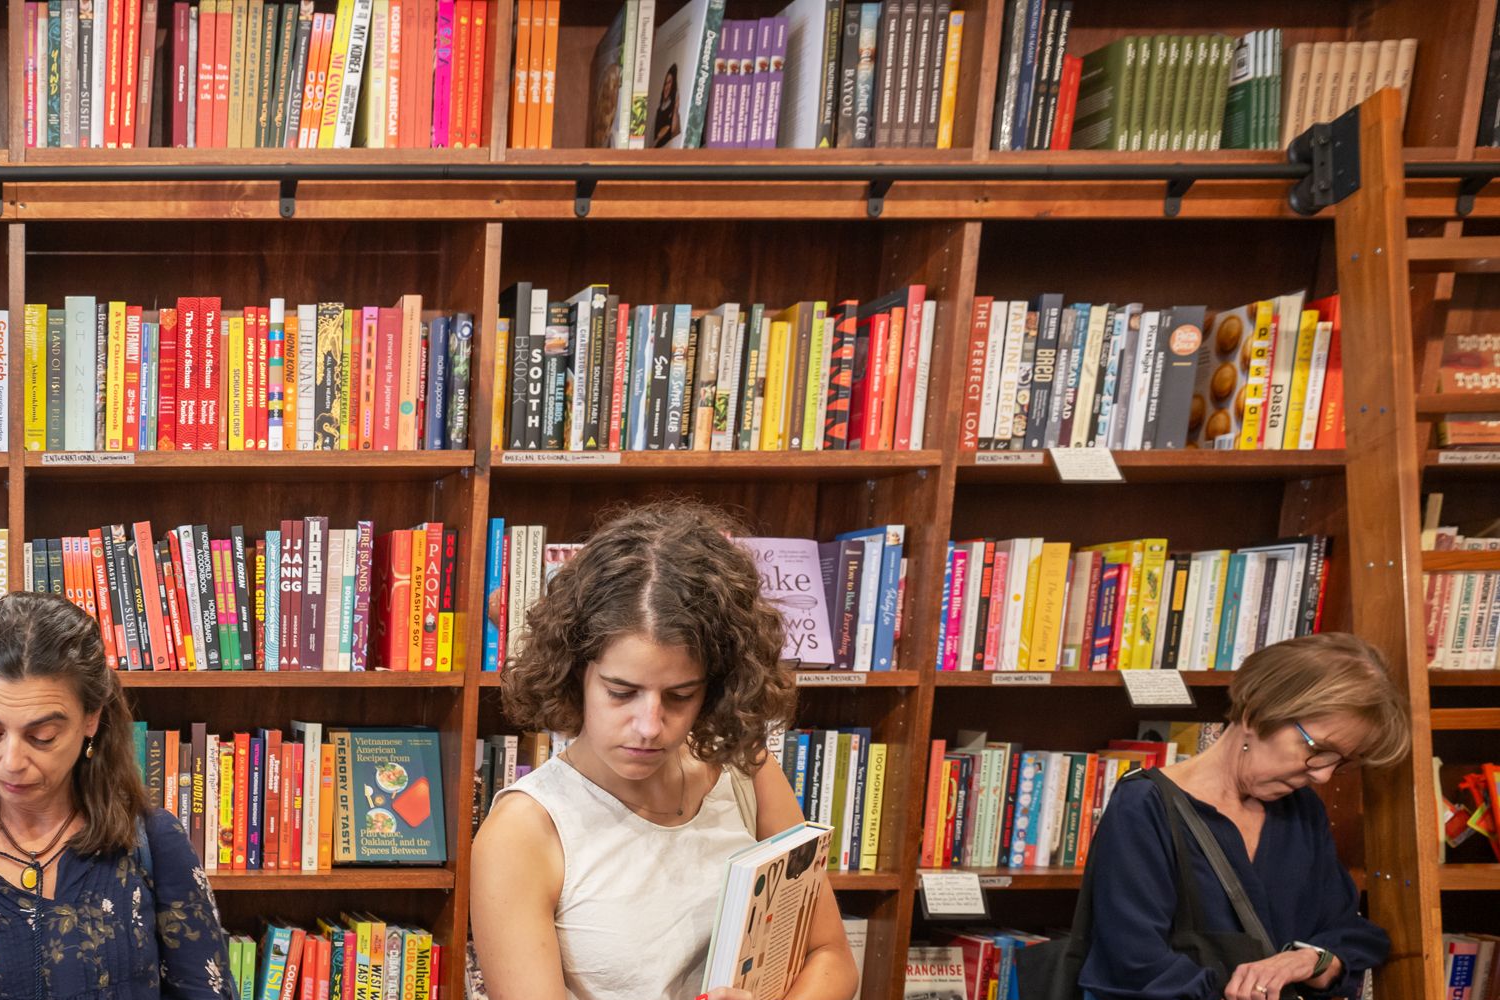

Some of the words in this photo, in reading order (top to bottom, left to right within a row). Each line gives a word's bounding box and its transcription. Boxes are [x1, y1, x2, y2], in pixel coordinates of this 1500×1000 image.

[391, 6, 400, 54] KOREAN
[389, 76, 400, 136] AMERICAN
[185, 311, 194, 326] The
[975, 303, 989, 329] THE
[184, 350, 193, 359] of
[185, 328, 194, 348] Food
[966, 341, 986, 401] PERFECT
[527, 349, 542, 428] SOUTH
[1269, 384, 1283, 428] pasta
[963, 413, 976, 448] LOAF
[360, 526, 370, 548] FIRE
[255, 555, 265, 585] CHILI
[280, 538, 291, 592] JANG
[358, 549, 370, 593] ISLANDS
[424, 544, 440, 609] PAON
[255, 589, 265, 622] CRISP
[354, 737, 403, 746] Vietnamese
[357, 754, 388, 763] Recipes
[337, 737, 347, 791] MEMORY
[875, 752, 884, 772] 100
[192, 773, 203, 814] NOODLES
[871, 773, 883, 815] MORNING
[341, 811, 351, 855] TASTE
[357, 963, 369, 988] EAST
[371, 965, 382, 991] WEST
[905, 964, 963, 977] RANCHISE
